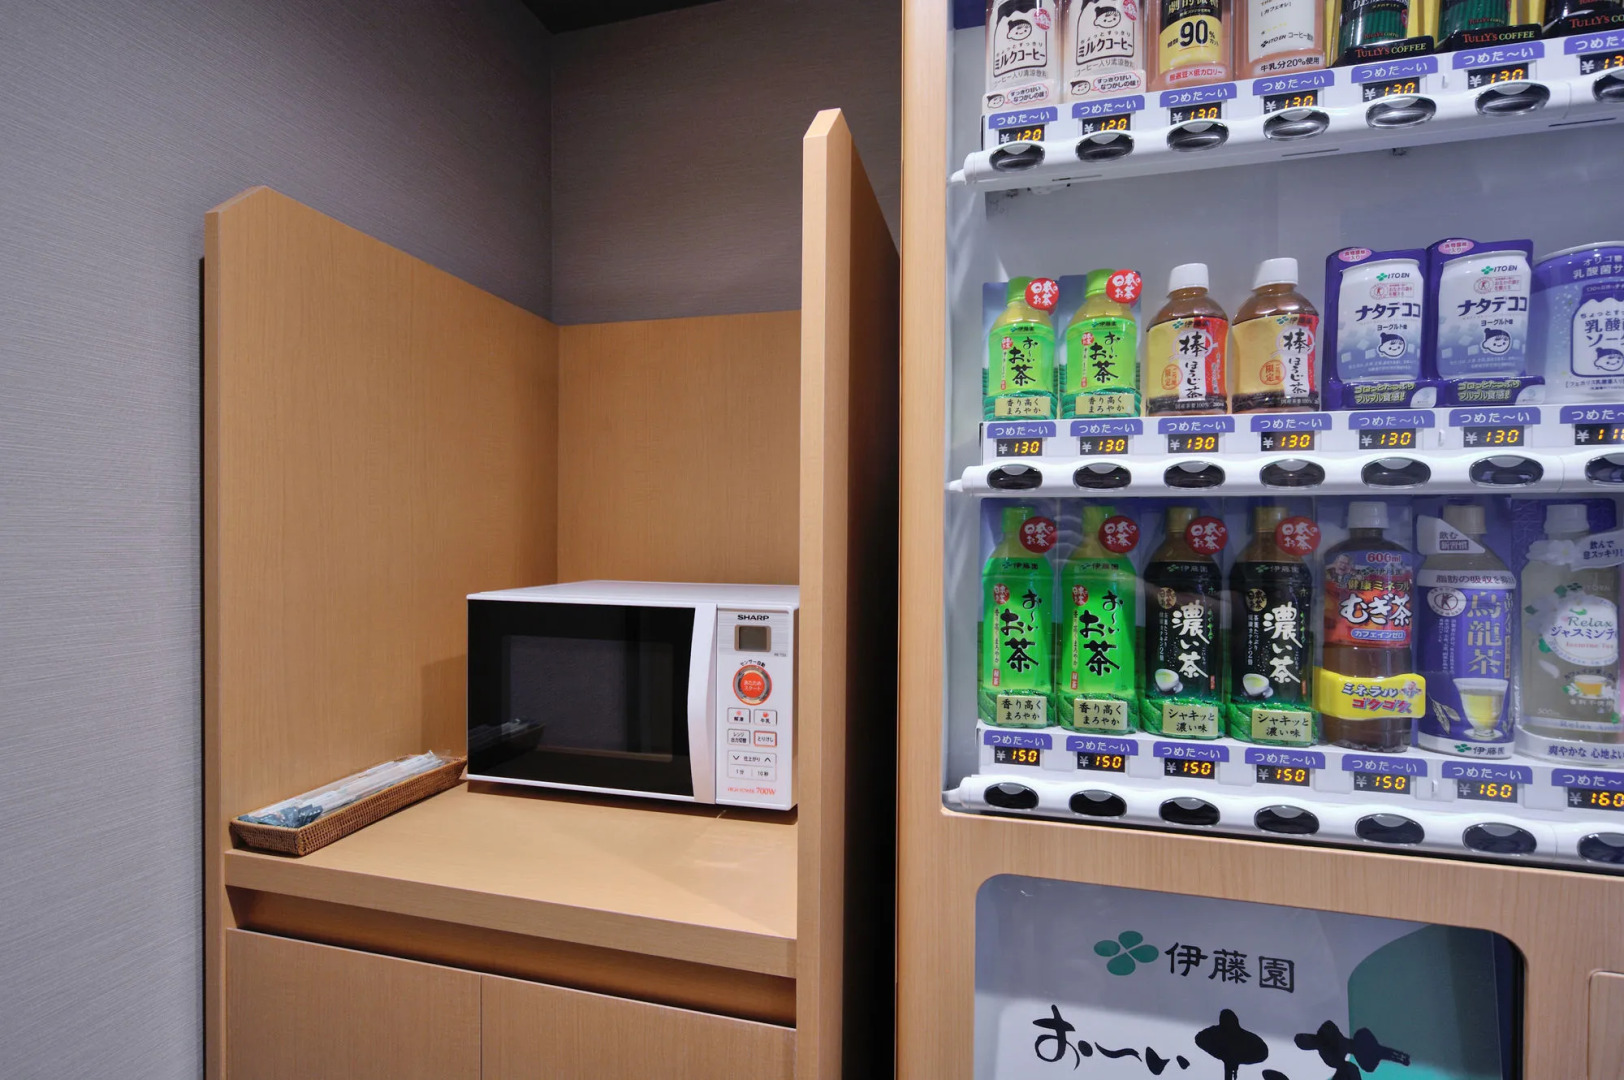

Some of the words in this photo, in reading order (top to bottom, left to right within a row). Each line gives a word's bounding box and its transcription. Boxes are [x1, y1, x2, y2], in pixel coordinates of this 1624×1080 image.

[1569, 15, 1610, 28] TULLY'S
[1180, 19, 1208, 47] 90
[1462, 33, 1498, 43] TULLY'S
[1499, 31, 1535, 40] COFFEE
[1078, 38, 1133, 57] ミルクコーヒー
[1355, 46, 1390, 58] TULLY'S
[1392, 43, 1426, 54] COFFEE
[995, 49, 1045, 70] ミルクコーヒー
[1490, 68, 1524, 84] 130
[1384, 82, 1416, 96] 130
[1284, 95, 1314, 109] 130
[1190, 107, 1218, 119] 130
[1100, 118, 1127, 132] 120
[1017, 129, 1042, 142] 120
[1355, 303, 1421, 322] ナタデココ
[1458, 296, 1528, 317] ナタデココ
[1584, 319, 1624, 335] 乳酸
[1008, 346, 1036, 386] お茶
[1089, 342, 1119, 384] お茶
[1006, 398, 1038, 406] 香り高く
[1088, 396, 1122, 405] 香り高く
[1006, 405, 1040, 414] まろやか
[1088, 405, 1124, 414] まろやか
[1186, 436, 1216, 450] 130
[1281, 434, 1310, 448] 130
[1380, 432, 1412, 446] 130
[1486, 429, 1519, 444] 130
[1014, 441, 1040, 454] 130
[1098, 438, 1126, 452] 130
[1440, 532, 1458, 540] 飲む
[1590, 540, 1614, 549] 飲んで
[1366, 552, 1401, 563] 600ml
[1348, 580, 1410, 592] 健康ミネラル
[1022, 588, 1042, 632] お〜い
[1102, 590, 1124, 634] お〜い
[1340, 593, 1412, 626] むぎ茶
[1568, 616, 1613, 628] Relax
[1000, 608, 1039, 673] お茶
[1172, 600, 1210, 678] 濃い茶
[1355, 630, 1404, 638] カフェインゼロ
[1079, 610, 1120, 676] お茶
[1262, 601, 1303, 684] 濃い茶
[1342, 682, 1398, 698] ミネラル
[1002, 698, 1042, 710] 香り高く
[1079, 702, 1122, 715] 香り高く
[1352, 697, 1413, 714] ゴクゴク
[1006, 711, 1040, 720] まろやか
[1083, 716, 1120, 726] まろやか
[1168, 709, 1214, 721] シャキッと
[1258, 714, 1309, 727] シャキッと
[1176, 722, 1208, 732] 濃い味
[1266, 727, 1302, 738] 濃い味
[1012, 750, 1038, 762] 150
[1548, 746, 1587, 757] 爽やかな
[1094, 756, 1122, 768] 150
[1182, 762, 1212, 775] 150
[1276, 768, 1306, 782] 150
[1375, 776, 1406, 790] 150
[1480, 784, 1512, 798] 160
[1165, 942, 1294, 993] 伊藤園
[1032, 1004, 1190, 1076] お〜い
